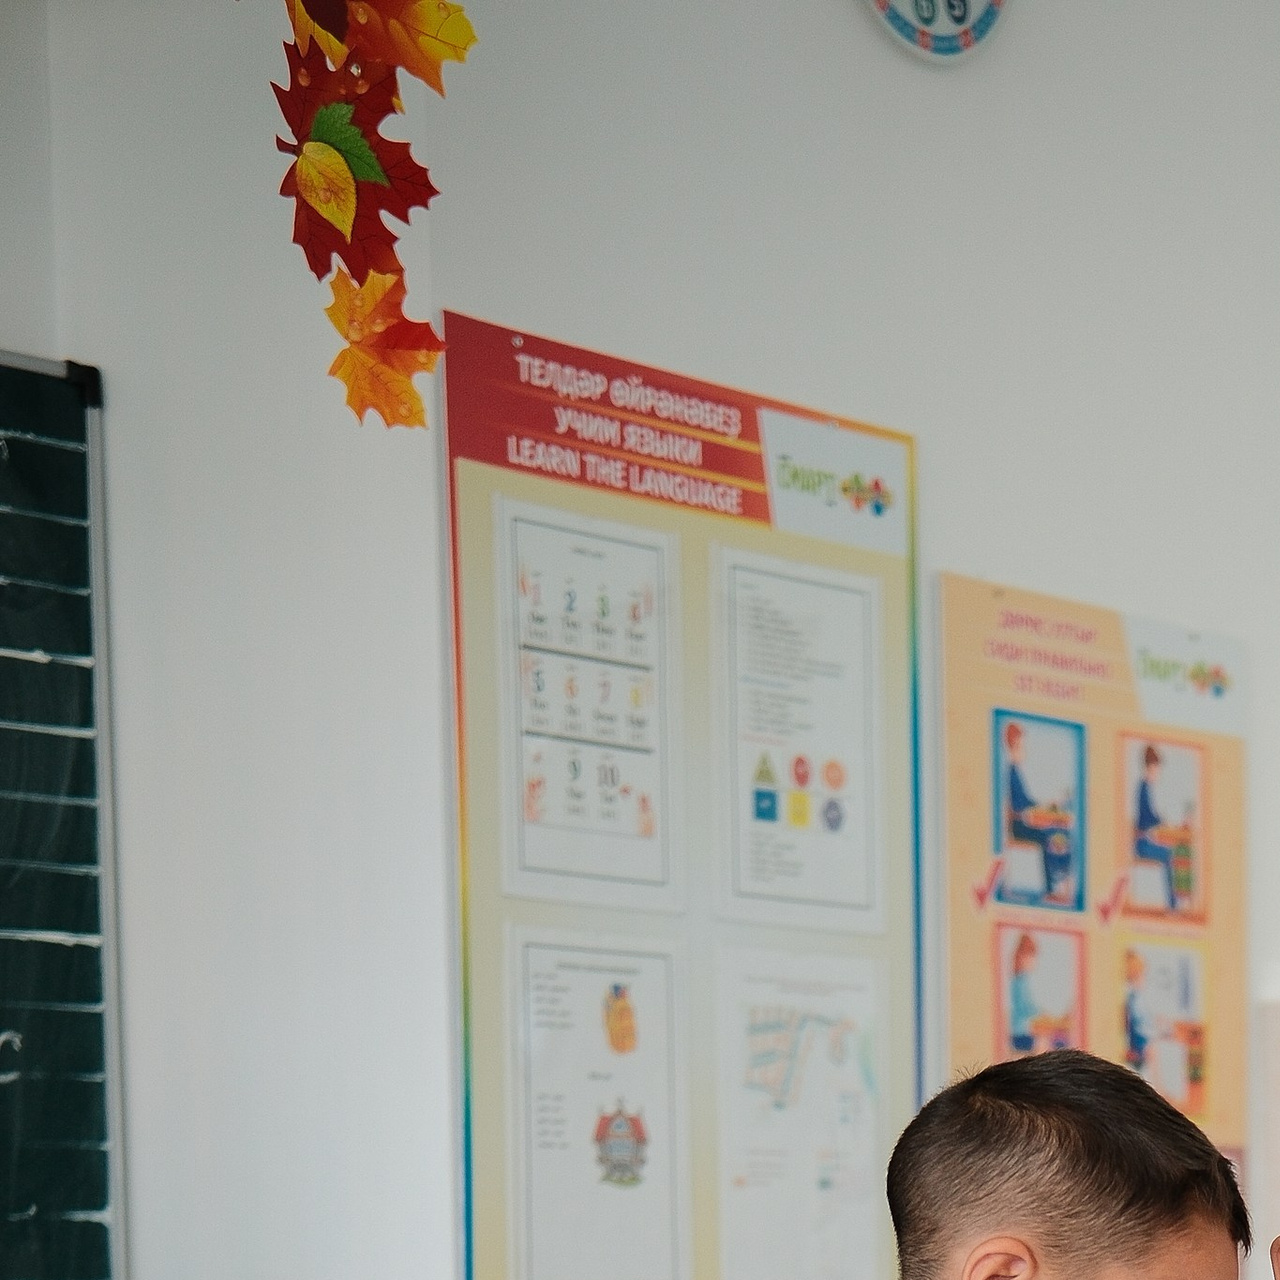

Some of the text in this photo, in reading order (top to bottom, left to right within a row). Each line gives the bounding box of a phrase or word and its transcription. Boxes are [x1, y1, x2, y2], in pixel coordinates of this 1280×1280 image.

[554, 406, 703, 466] УЧИМ ЯЗЫКИ
[506, 435, 743, 515] LEARN THE LANGUAGE
